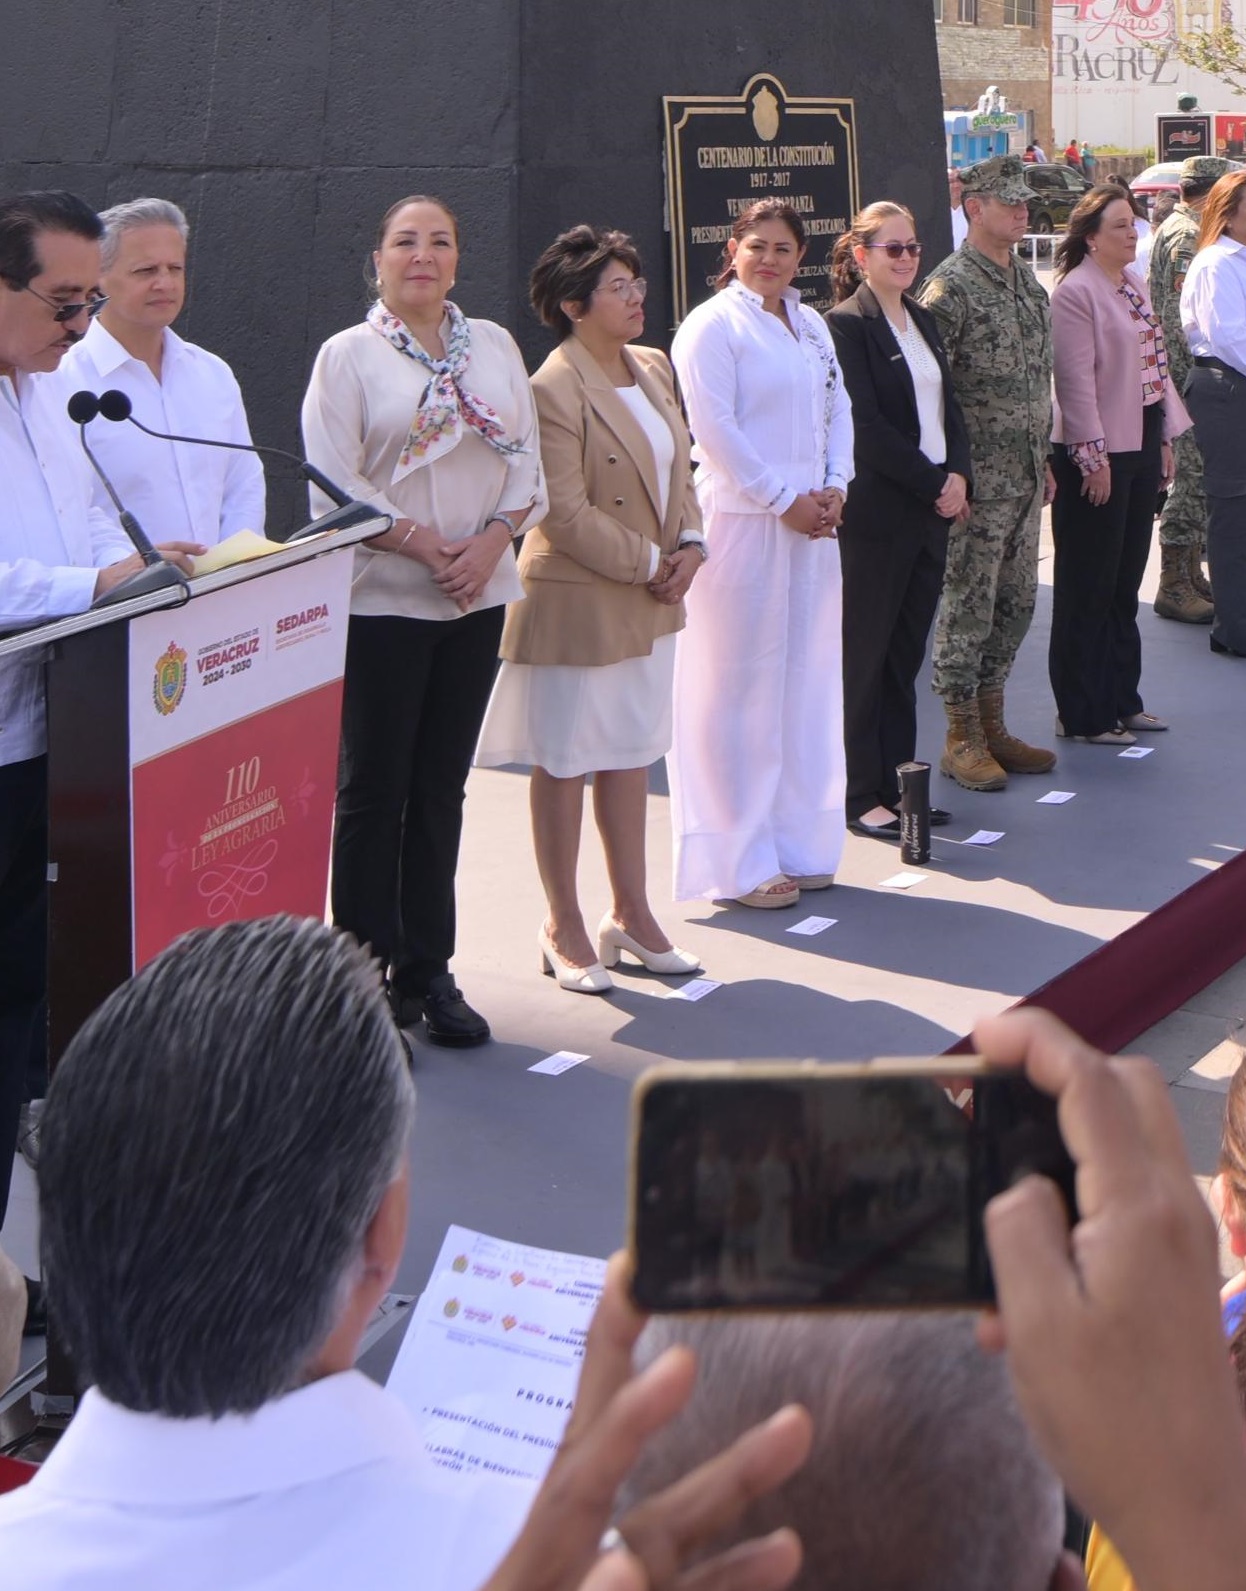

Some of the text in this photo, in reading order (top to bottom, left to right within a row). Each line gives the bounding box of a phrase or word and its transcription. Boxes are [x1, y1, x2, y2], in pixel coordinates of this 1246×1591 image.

[1053, 33, 1180, 86] RACRUZ
[697, 141, 835, 169] CENTENARIO DE LA CONSTITUCIÓN
[750, 173, 768, 188] 1917
[773, 172, 790, 187] 2017
[275, 603, 329, 634] SEDARPA
[196, 637, 260, 674] VERACRUZ
[202, 669, 224, 687] 2024
[230, 658, 252, 676] 2030
[223, 756, 260, 806] 110
[203, 785, 276, 833] ANIVERSARIO
[191, 839, 220, 872] LEY
[221, 805, 286, 857] AGRARIA
[516, 1387, 574, 1410] PROGRA
